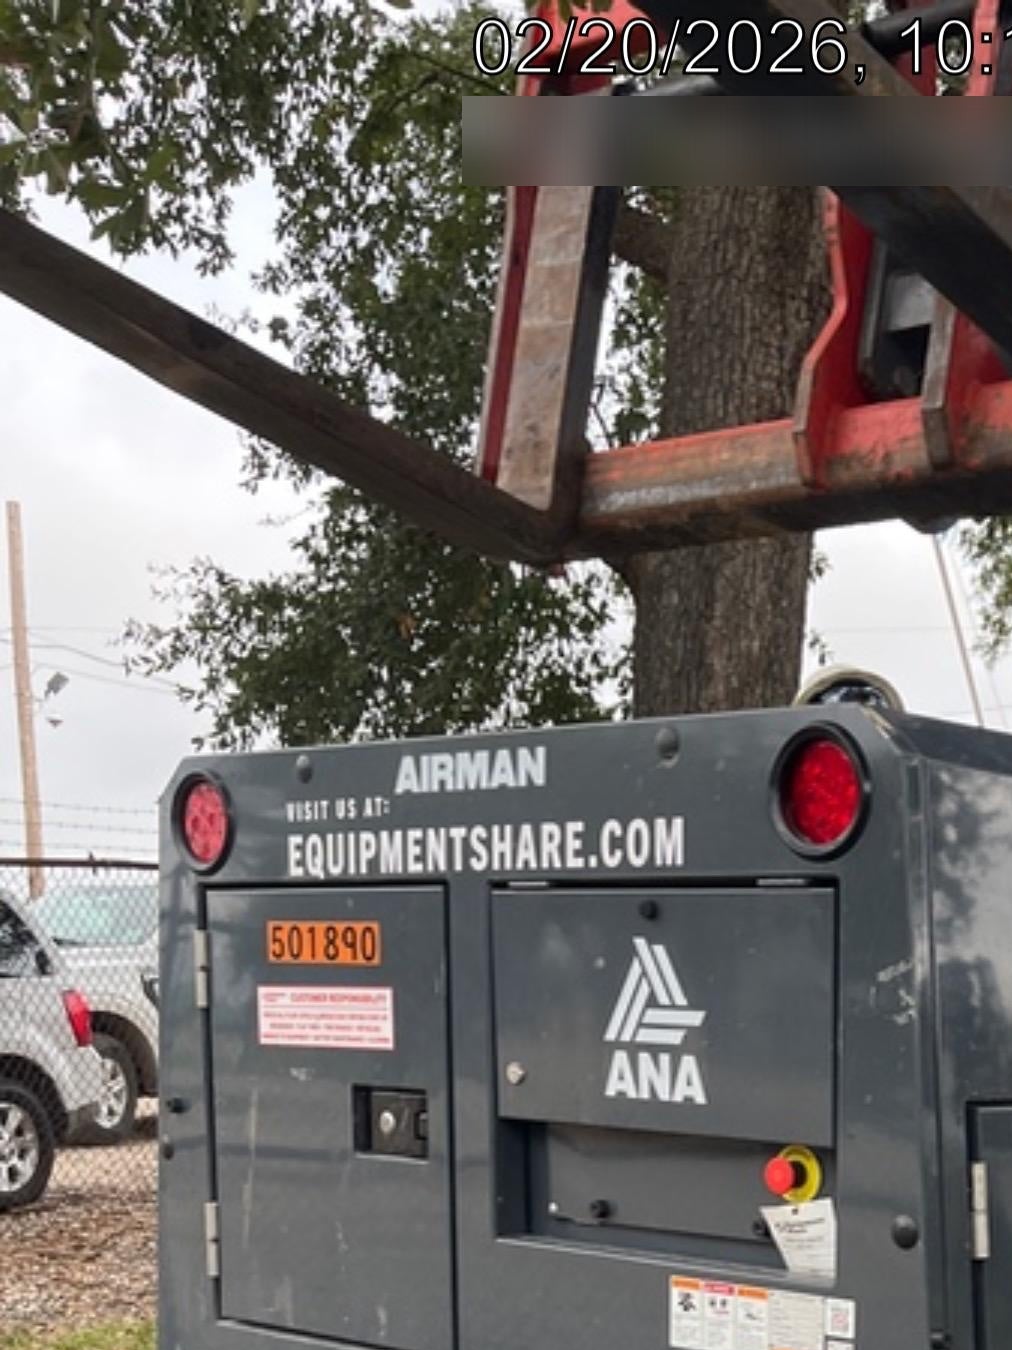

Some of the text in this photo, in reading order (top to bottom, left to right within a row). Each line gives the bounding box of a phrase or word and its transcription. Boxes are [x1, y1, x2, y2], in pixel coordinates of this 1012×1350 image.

[394, 746, 547, 795] AIRMAN
[285, 796, 391, 823] VISIT US AT:
[286, 816, 685, 880] EQUIPMENTSHARE.COM
[271, 925, 376, 962] 501890
[604, 1049, 708, 1105] ANA
